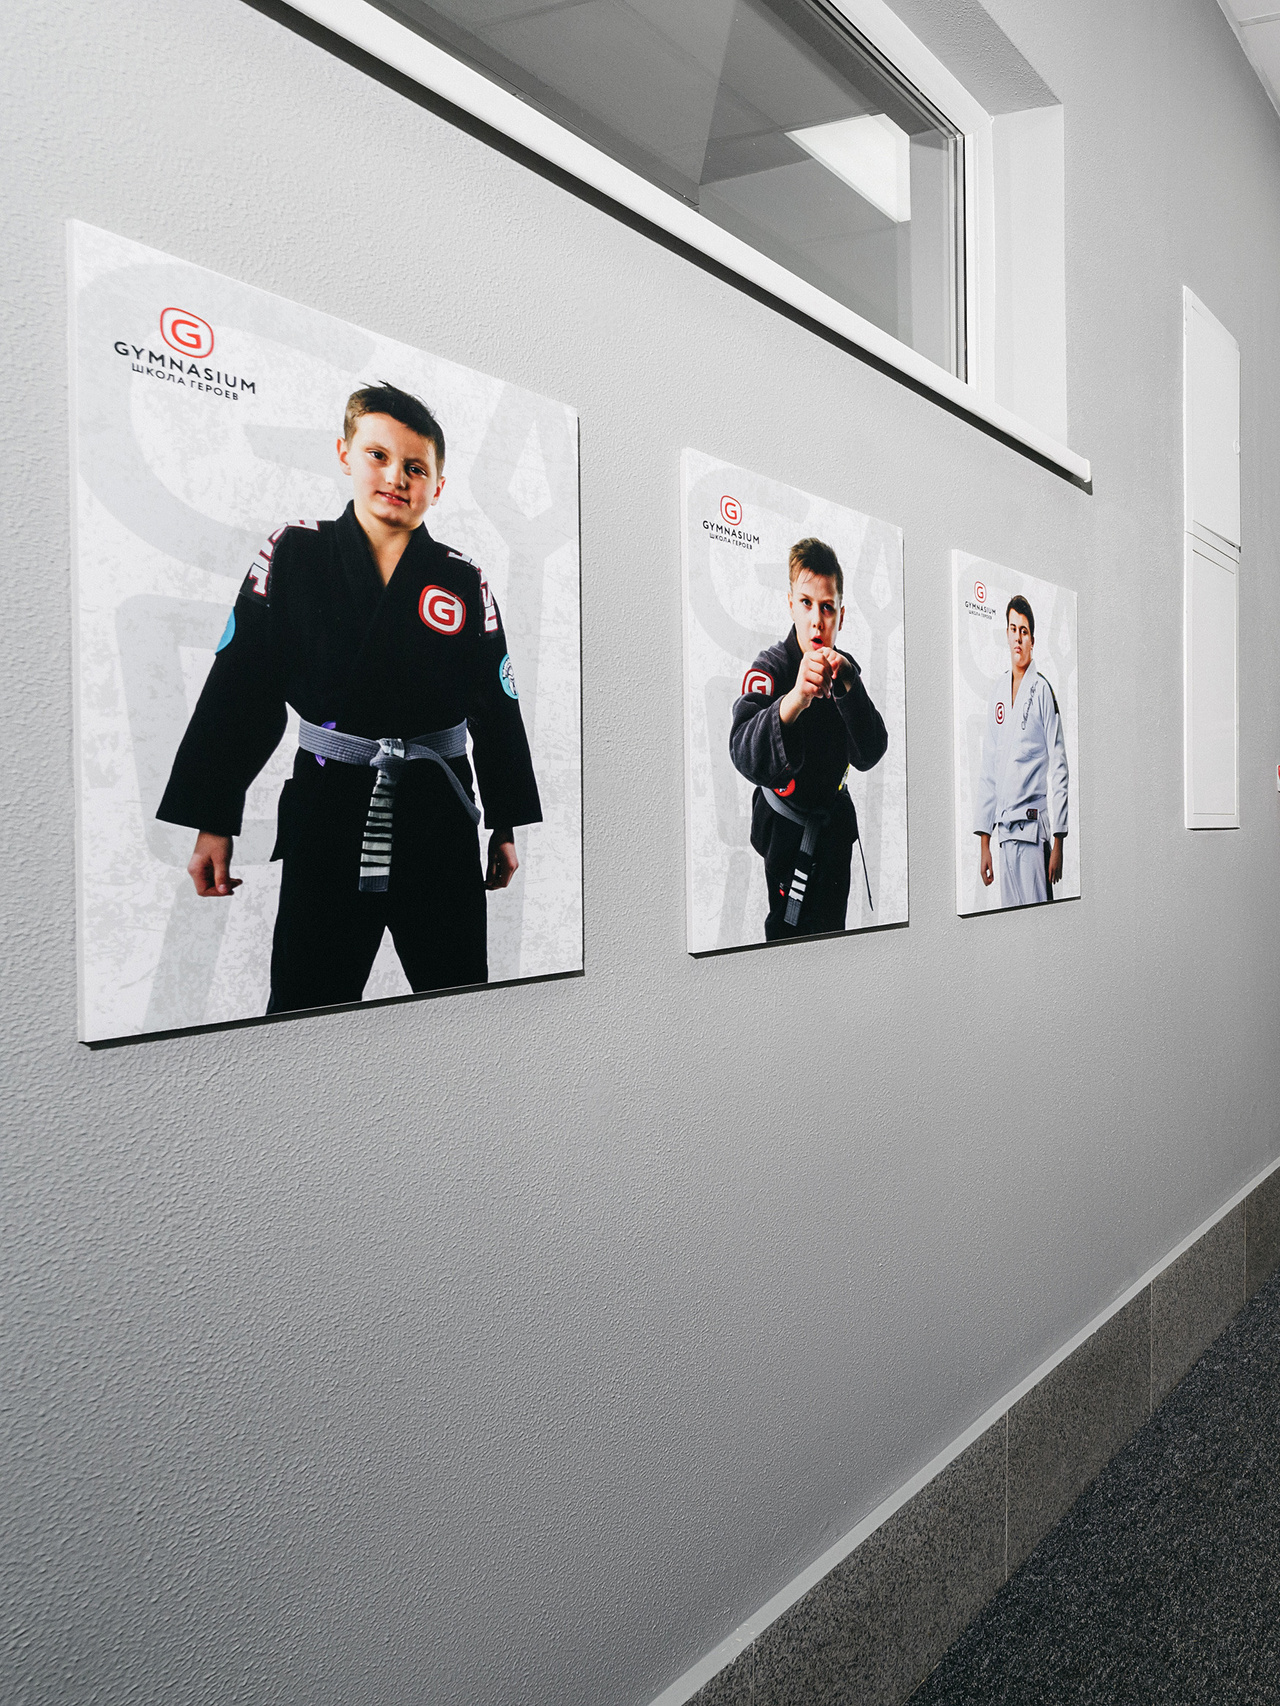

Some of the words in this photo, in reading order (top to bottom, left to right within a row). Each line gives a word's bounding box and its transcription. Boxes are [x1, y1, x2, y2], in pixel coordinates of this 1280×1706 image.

[114, 341, 256, 394] GYMNASIUM
[131, 362, 186, 386] ШКОЛА
[190, 380, 239, 401] ГЕРОЕВ
[702, 520, 760, 544] GYMNASIUM
[709, 533, 731, 544] ШКОЛА
[732, 540, 753, 550] ГЕРОЕВ
